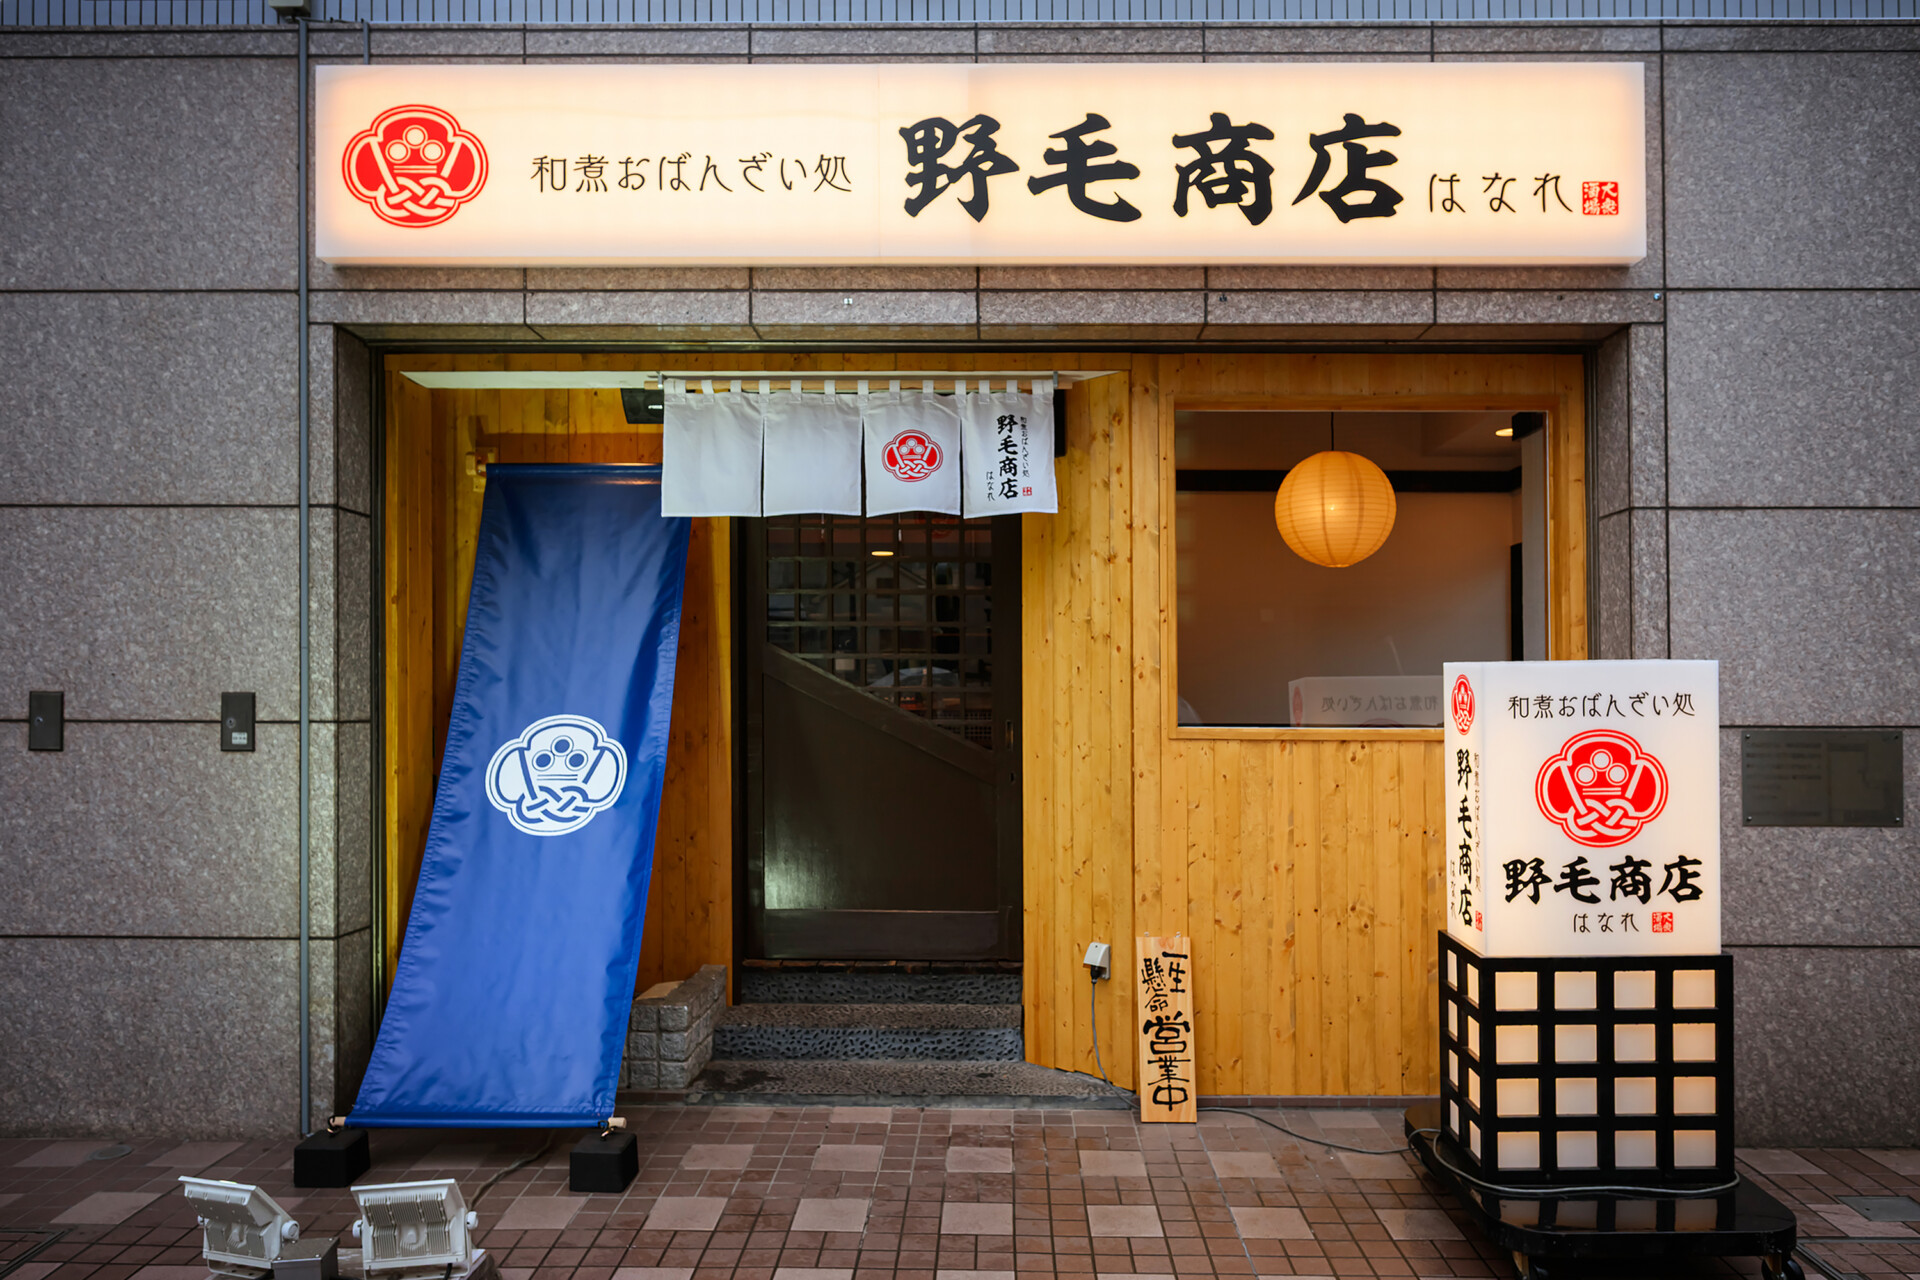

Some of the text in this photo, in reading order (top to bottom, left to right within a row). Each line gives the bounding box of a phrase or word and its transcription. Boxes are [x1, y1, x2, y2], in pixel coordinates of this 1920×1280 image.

[530, 151, 852, 193] 和煮おばんざい処
[899, 113, 1403, 226] 野毛商店
[1430, 173, 1573, 213] はなれ
[997, 413, 1019, 499] 野毛商店
[1508, 692, 1696, 719] 和煮おばんざい処
[1456, 749, 1472, 926] 野毛商店
[1502, 854, 1704, 905] 野毛商店
[1573, 912, 1640, 933] はなれ
[1143, 1011, 1191, 1111] 営業中
